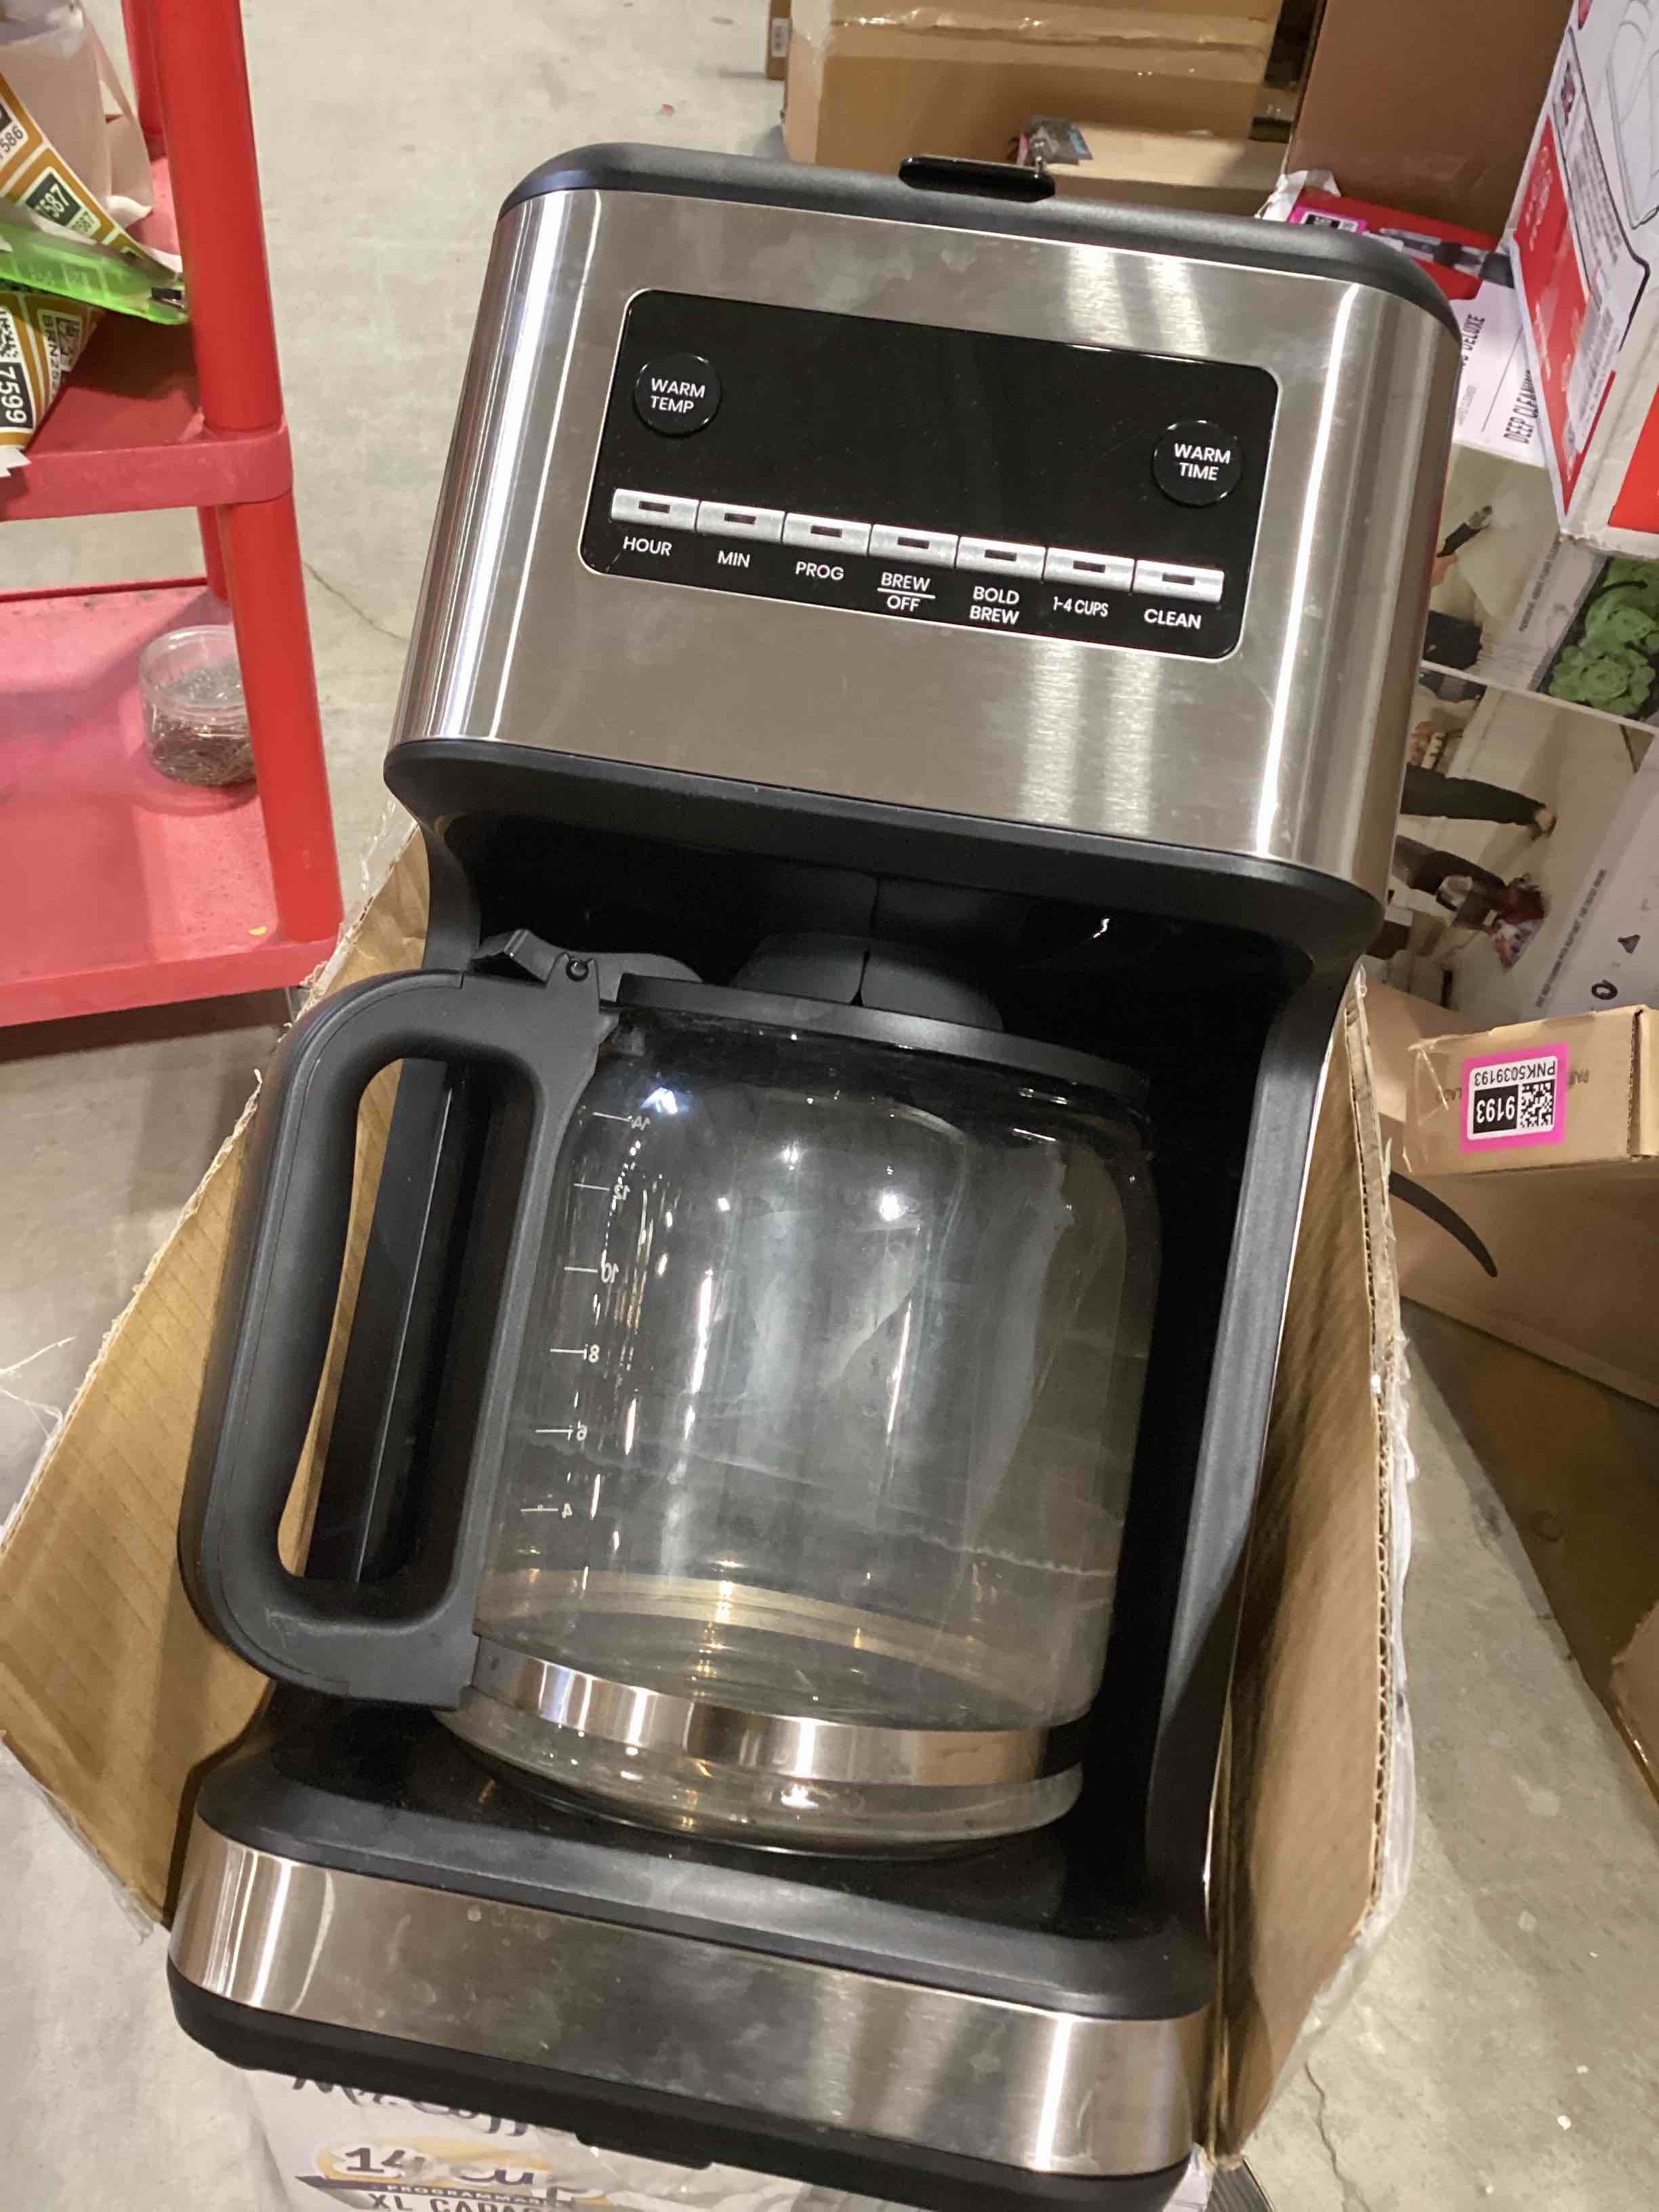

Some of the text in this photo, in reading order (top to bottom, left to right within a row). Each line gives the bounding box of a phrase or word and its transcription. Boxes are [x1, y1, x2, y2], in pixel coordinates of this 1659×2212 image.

[0, 366, 28, 424] 7599
[651, 377, 705, 398] WARM
[650, 395, 695, 413] TEMP
[1503, 416, 1534, 445] DEEP
[1174, 443, 1231, 464] WARM
[1179, 462, 1219, 481] TIME
[623, 535, 672, 556] HOUR
[717, 550, 750, 568] MIN
[795, 561, 844, 581] PROG
[880, 571, 931, 592] BREW
[886, 594, 921, 612] OFF
[972, 586, 1020, 605] BOLD
[969, 605, 1020, 625] BREW
[1053, 596, 1109, 617] 1-4 CUPS
[1143, 608, 1202, 630] CLEAN
[1474, 1060, 1556, 1086] PNK5039193
[1476, 1095, 1516, 1124] 9193
[368, 2193, 413, 2212] XL
